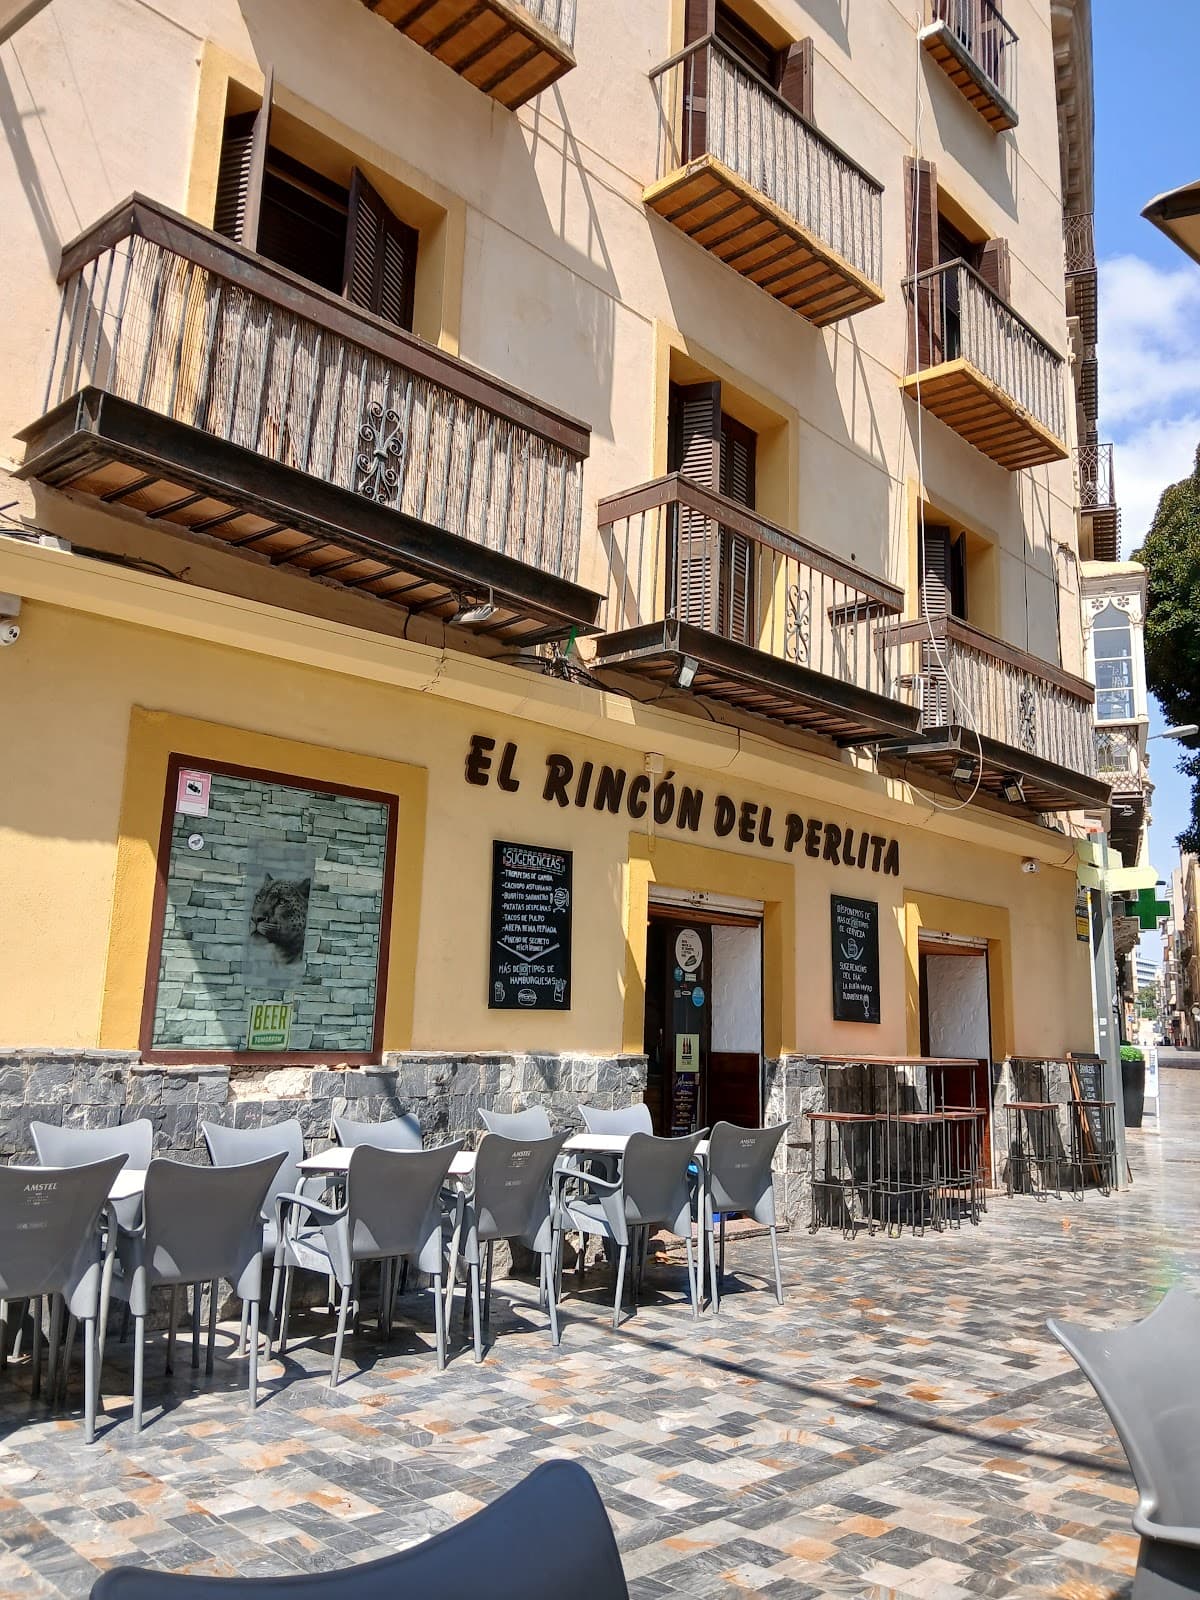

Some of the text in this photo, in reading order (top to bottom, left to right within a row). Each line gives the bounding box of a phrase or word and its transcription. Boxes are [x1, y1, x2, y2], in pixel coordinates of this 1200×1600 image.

[465, 734, 900, 877] EL RINCÓN DEL PERLITA
[506, 851, 561, 870] SUGERENCIAS
[528, 914, 545, 922] PULPO
[864, 912, 871, 921] DE
[839, 925, 865, 938] DE CERVEZA
[522, 936, 529, 944] DE
[529, 936, 550, 945] SECRETO
[499, 962, 512, 974] MÁS
[512, 965, 520, 973] DE
[528, 964, 546, 974] TIPOS
[547, 965, 555, 973] DE
[840, 962, 867, 973] SUGERENCIAS
[510, 976, 556, 985] HAMBURGUESAS
[842, 971, 851, 980] DEL
[254, 1005, 288, 1030] BEER
[23, 1182, 57, 1192] AMSTEL
